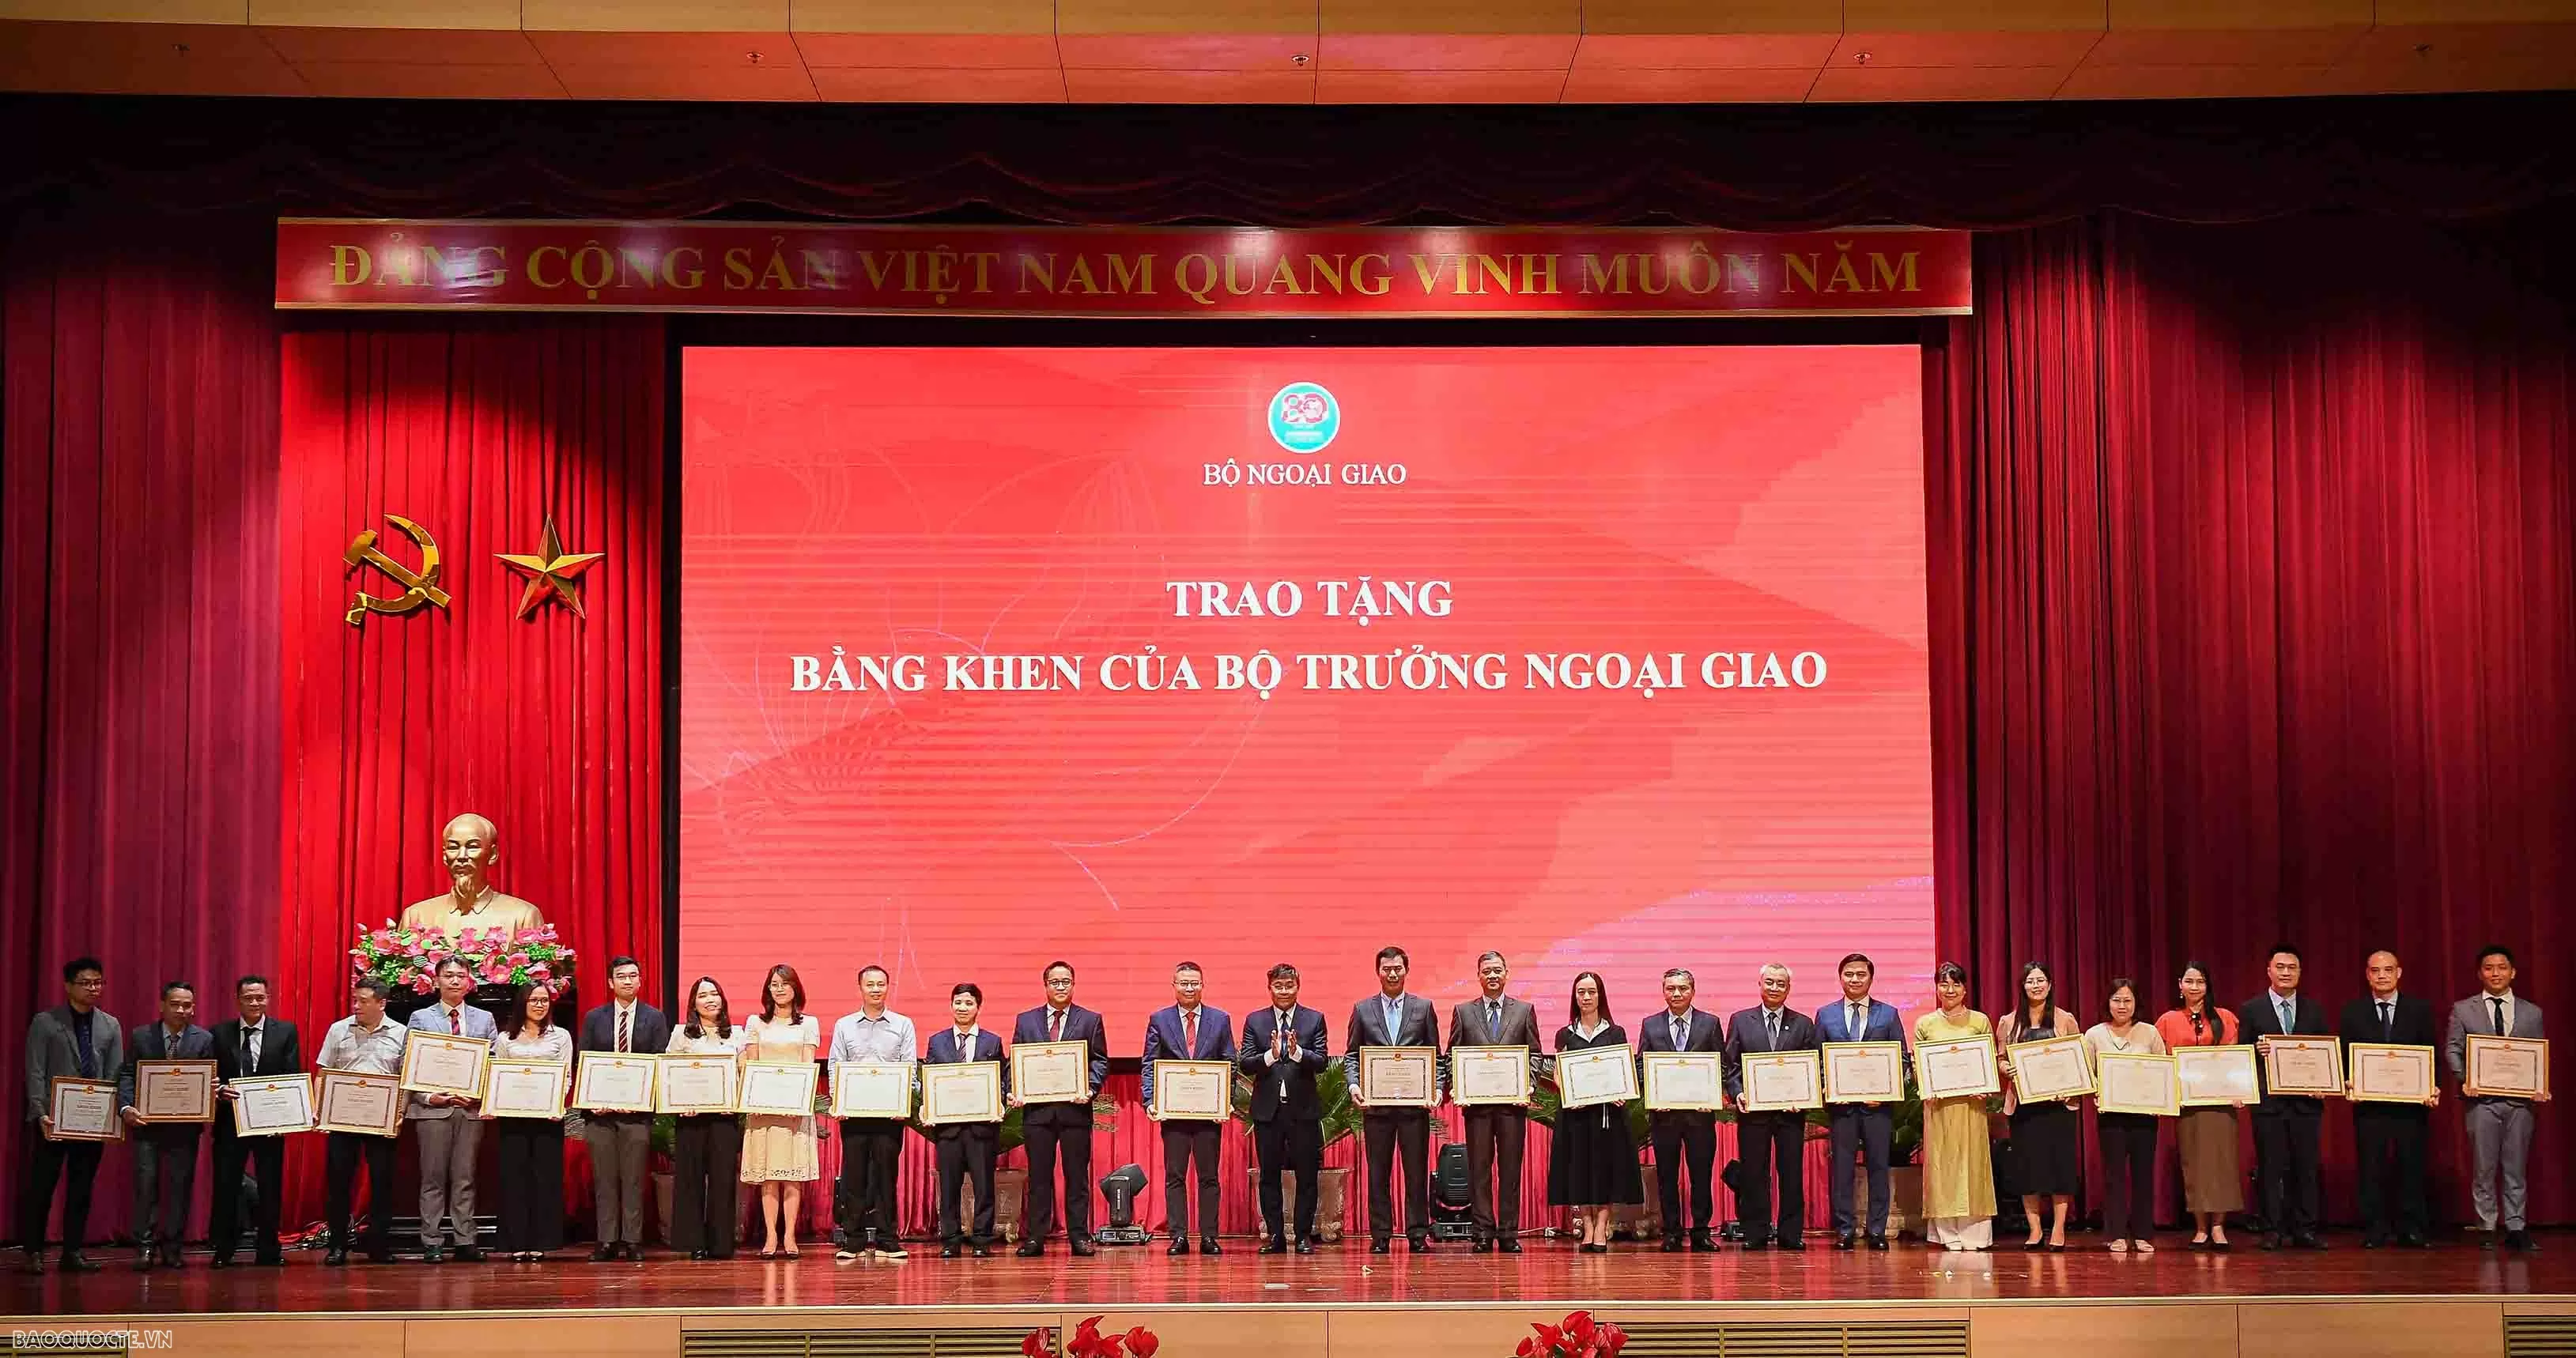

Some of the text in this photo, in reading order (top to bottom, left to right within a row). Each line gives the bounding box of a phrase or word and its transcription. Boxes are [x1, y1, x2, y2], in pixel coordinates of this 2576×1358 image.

[330, 232, 1921, 305] ĐẢNG CỘNG SẢN VIỆT NAM QUANG VINH MUÔN NĂM
[1203, 458, 1407, 487] BỘ NGOẠI GIAO
[1165, 575, 1453, 626] TRAO TẶNG
[791, 644, 1827, 700] BẰNG KHEN CỦA BỘ TRƯỞNG NGOẠI GIAO
